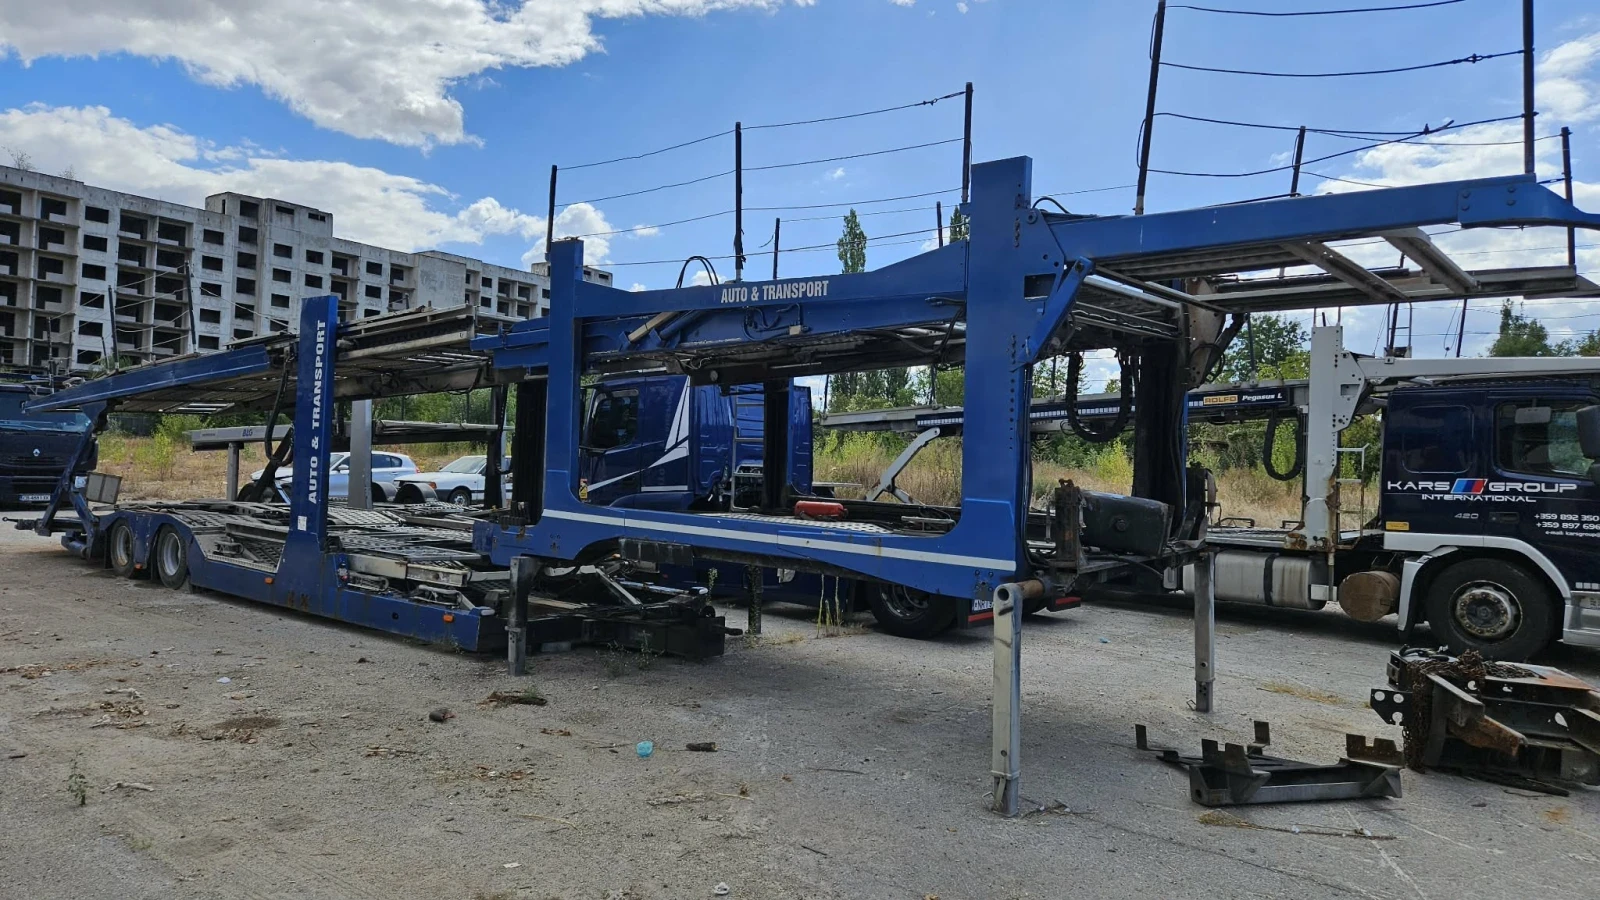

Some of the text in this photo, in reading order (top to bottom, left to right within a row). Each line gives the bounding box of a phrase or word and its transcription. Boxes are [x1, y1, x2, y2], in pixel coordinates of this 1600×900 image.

[721, 281, 829, 303] AUTO & TRANSPORT
[1204, 396, 1237, 404] ROLFO
[308, 320, 326, 504] AUTO & TRANSPORT
[1387, 480, 1577, 493] KARS GROUP
[1421, 493, 1537, 503] INTERNATIONAL
[1454, 512, 1479, 520] 420
[1536, 521, 1560, 529] +359
